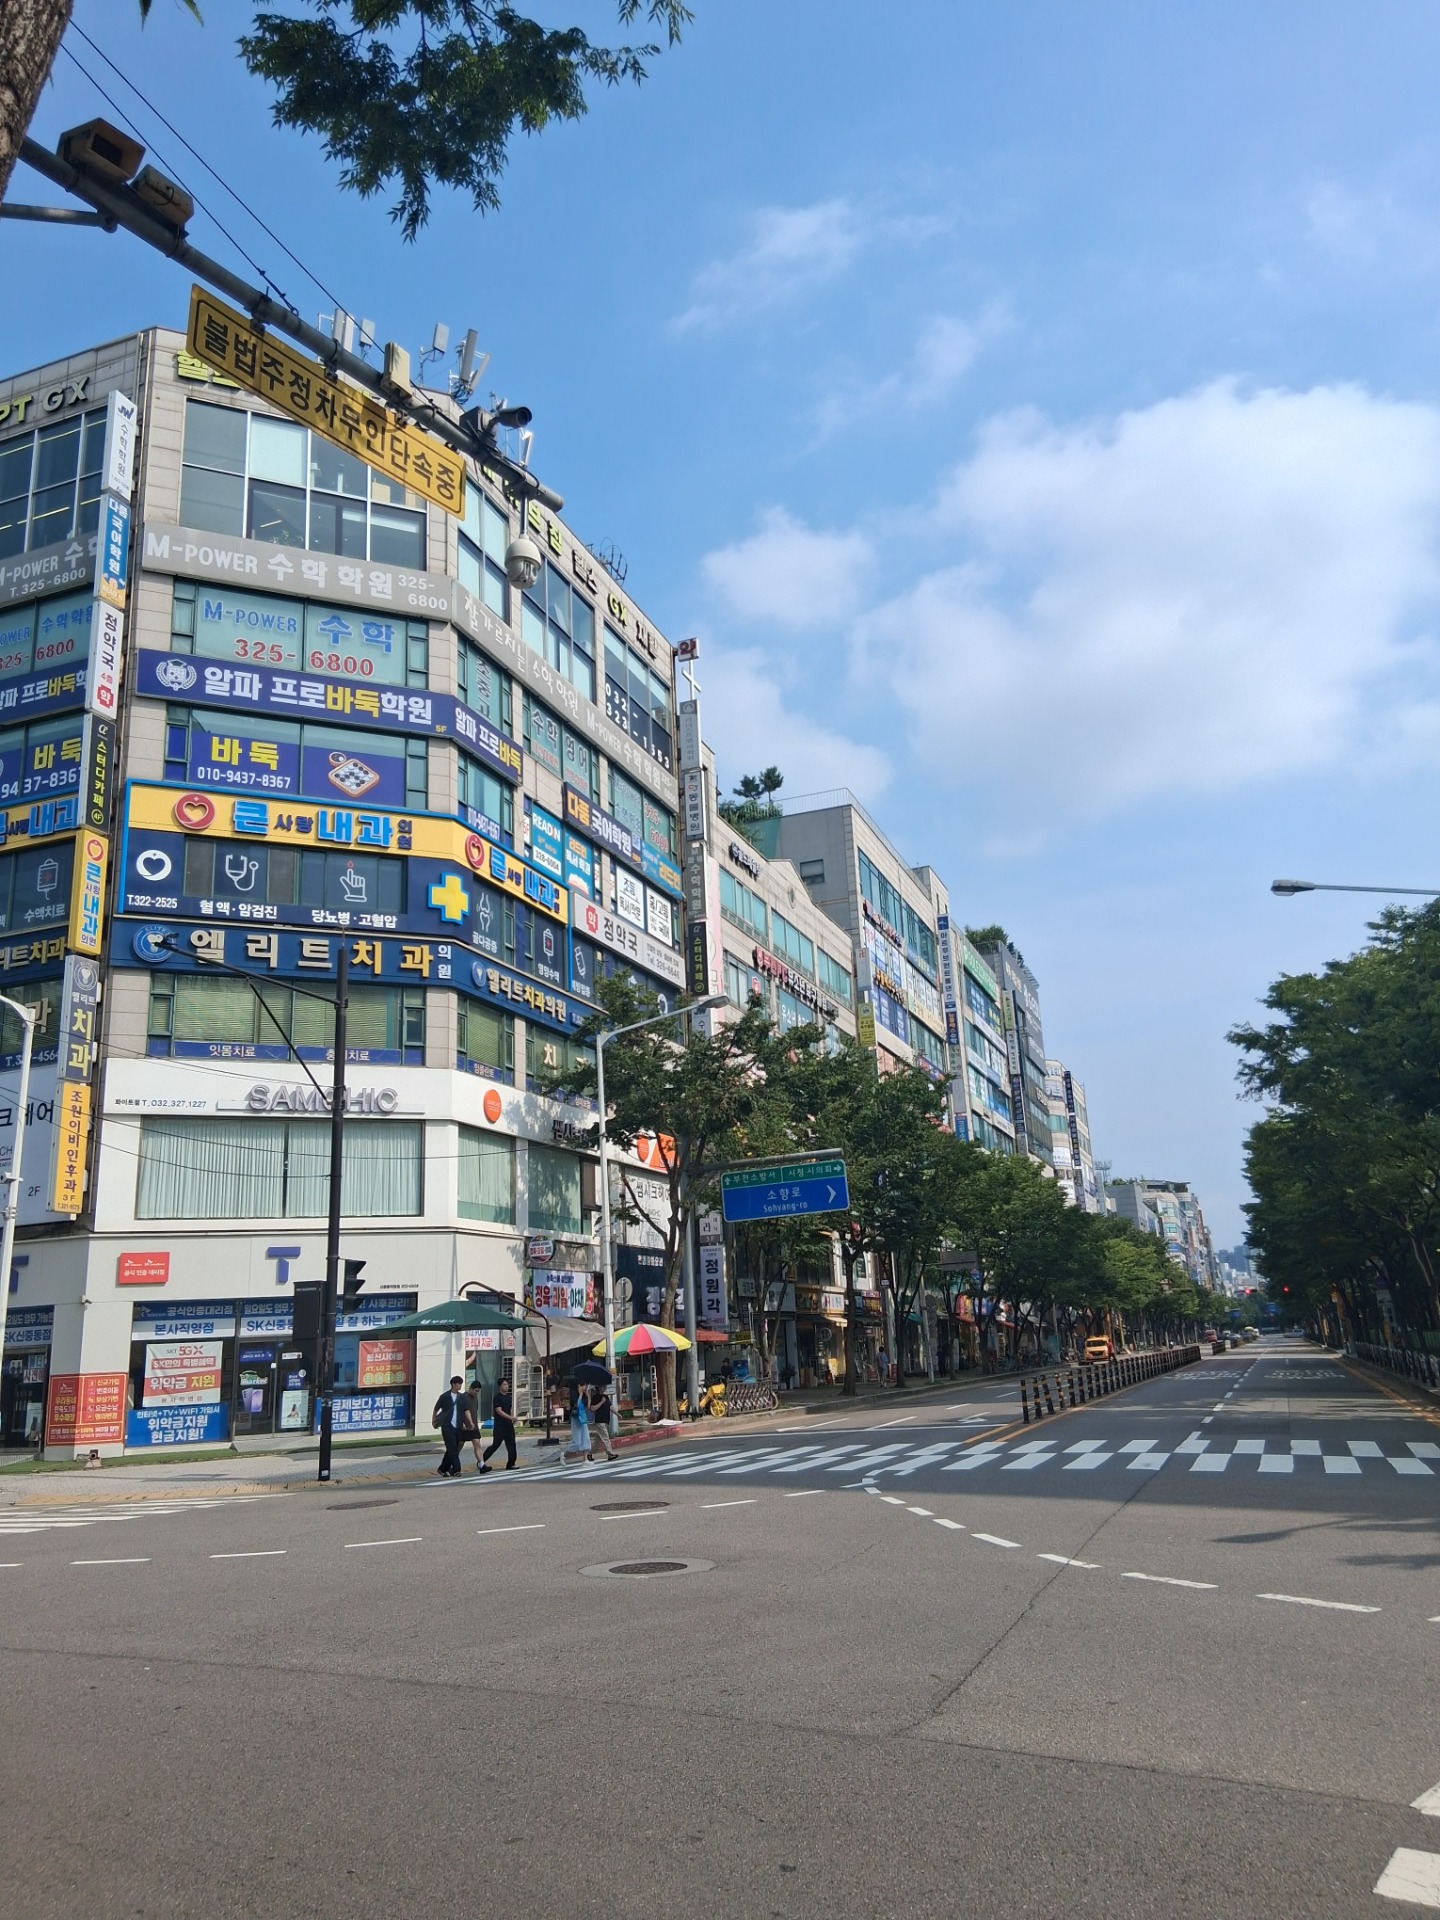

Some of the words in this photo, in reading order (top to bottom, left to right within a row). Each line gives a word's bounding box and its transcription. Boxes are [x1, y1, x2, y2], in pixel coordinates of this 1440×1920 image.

[42, 377, 89, 412] GX
[202, 313, 458, 503] 불법주정차무인단속중
[109, 515, 125, 575] 국어학원
[146, 532, 258, 575] M-POWER
[397, 574, 435, 590] 325-
[408, 593, 448, 611] 6800
[607, 592, 627, 627] GX
[101, 612, 118, 671] 정약국
[203, 599, 297, 633] M-POWER
[319, 615, 395, 653] 수학
[36, 639, 74, 660] 6800
[234, 638, 296, 663] 325-
[310, 650, 374, 676] 6800
[204, 667, 262, 700] 알파
[270, 677, 432, 725] 프로바둑학원
[455, 707, 477, 742] 알파
[33, 738, 81, 770] 바둑
[211, 736, 279, 771] 바둑
[93, 741, 107, 808] 스터디카페
[197, 767, 291, 789] 010-9437-8367
[532, 812, 561, 842] READIN
[24, 903, 66, 922] 수액치료
[127, 894, 178, 909] T.322-2525
[604, 917, 638, 957] 정약국
[693, 937, 704, 981] 스터디카페
[68, 1008, 92, 1077] 치과
[210, 1045, 256, 1058] 잇몸치료
[64, 1090, 84, 1193] 조원이비인후과
[28, 1186, 41, 1197] 2F
[733, 1171, 776, 1183] 부천소방서
[767, 1187, 802, 1200] 소향로
[763, 1202, 808, 1213] Sohyang-ro
[705, 1259, 721, 1314] 정원각
[154, 1322, 215, 1336] 본사직영점
[147, 1414, 208, 1430] 위약금지원
